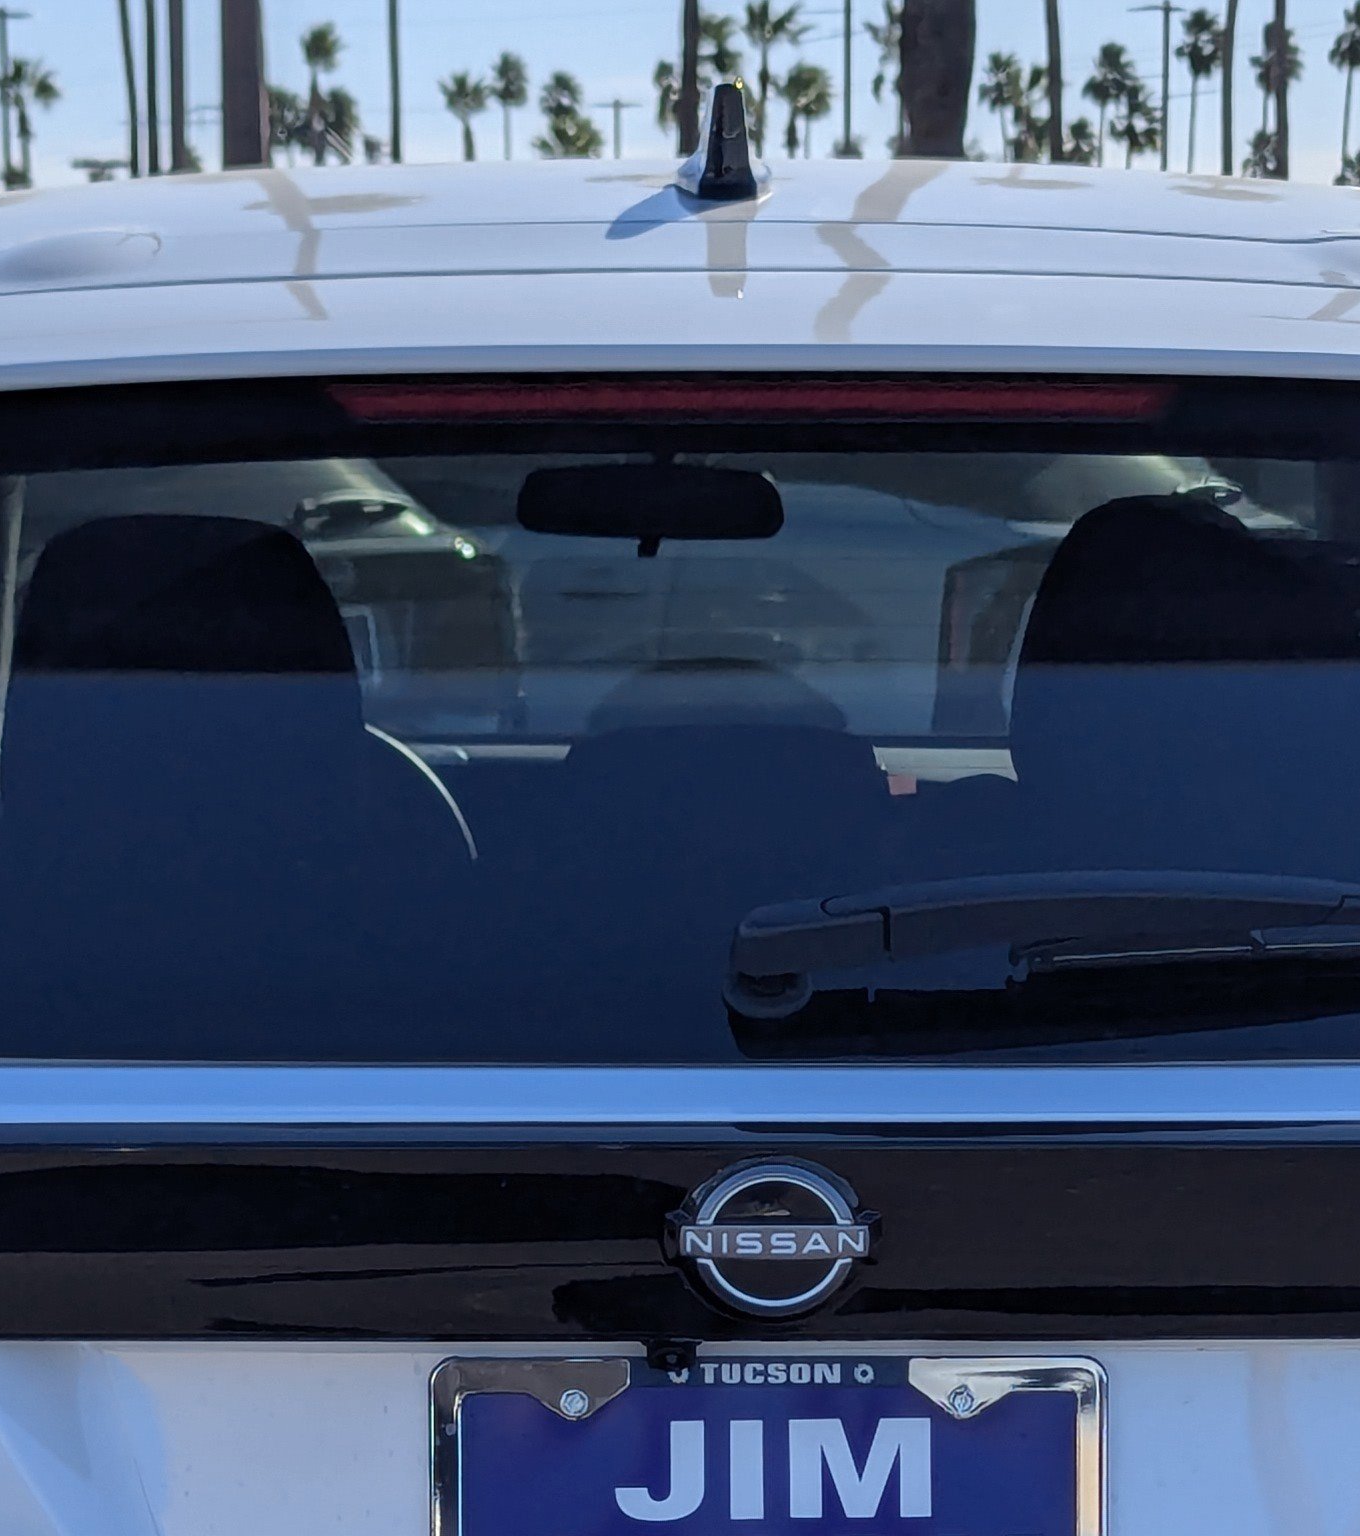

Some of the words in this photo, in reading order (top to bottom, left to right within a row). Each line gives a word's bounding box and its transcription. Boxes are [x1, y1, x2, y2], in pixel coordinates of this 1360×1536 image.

[685, 1230, 865, 1255] NISSAN
[699, 1362, 841, 1385] TUCSON
[614, 1416, 933, 1521] JIM
